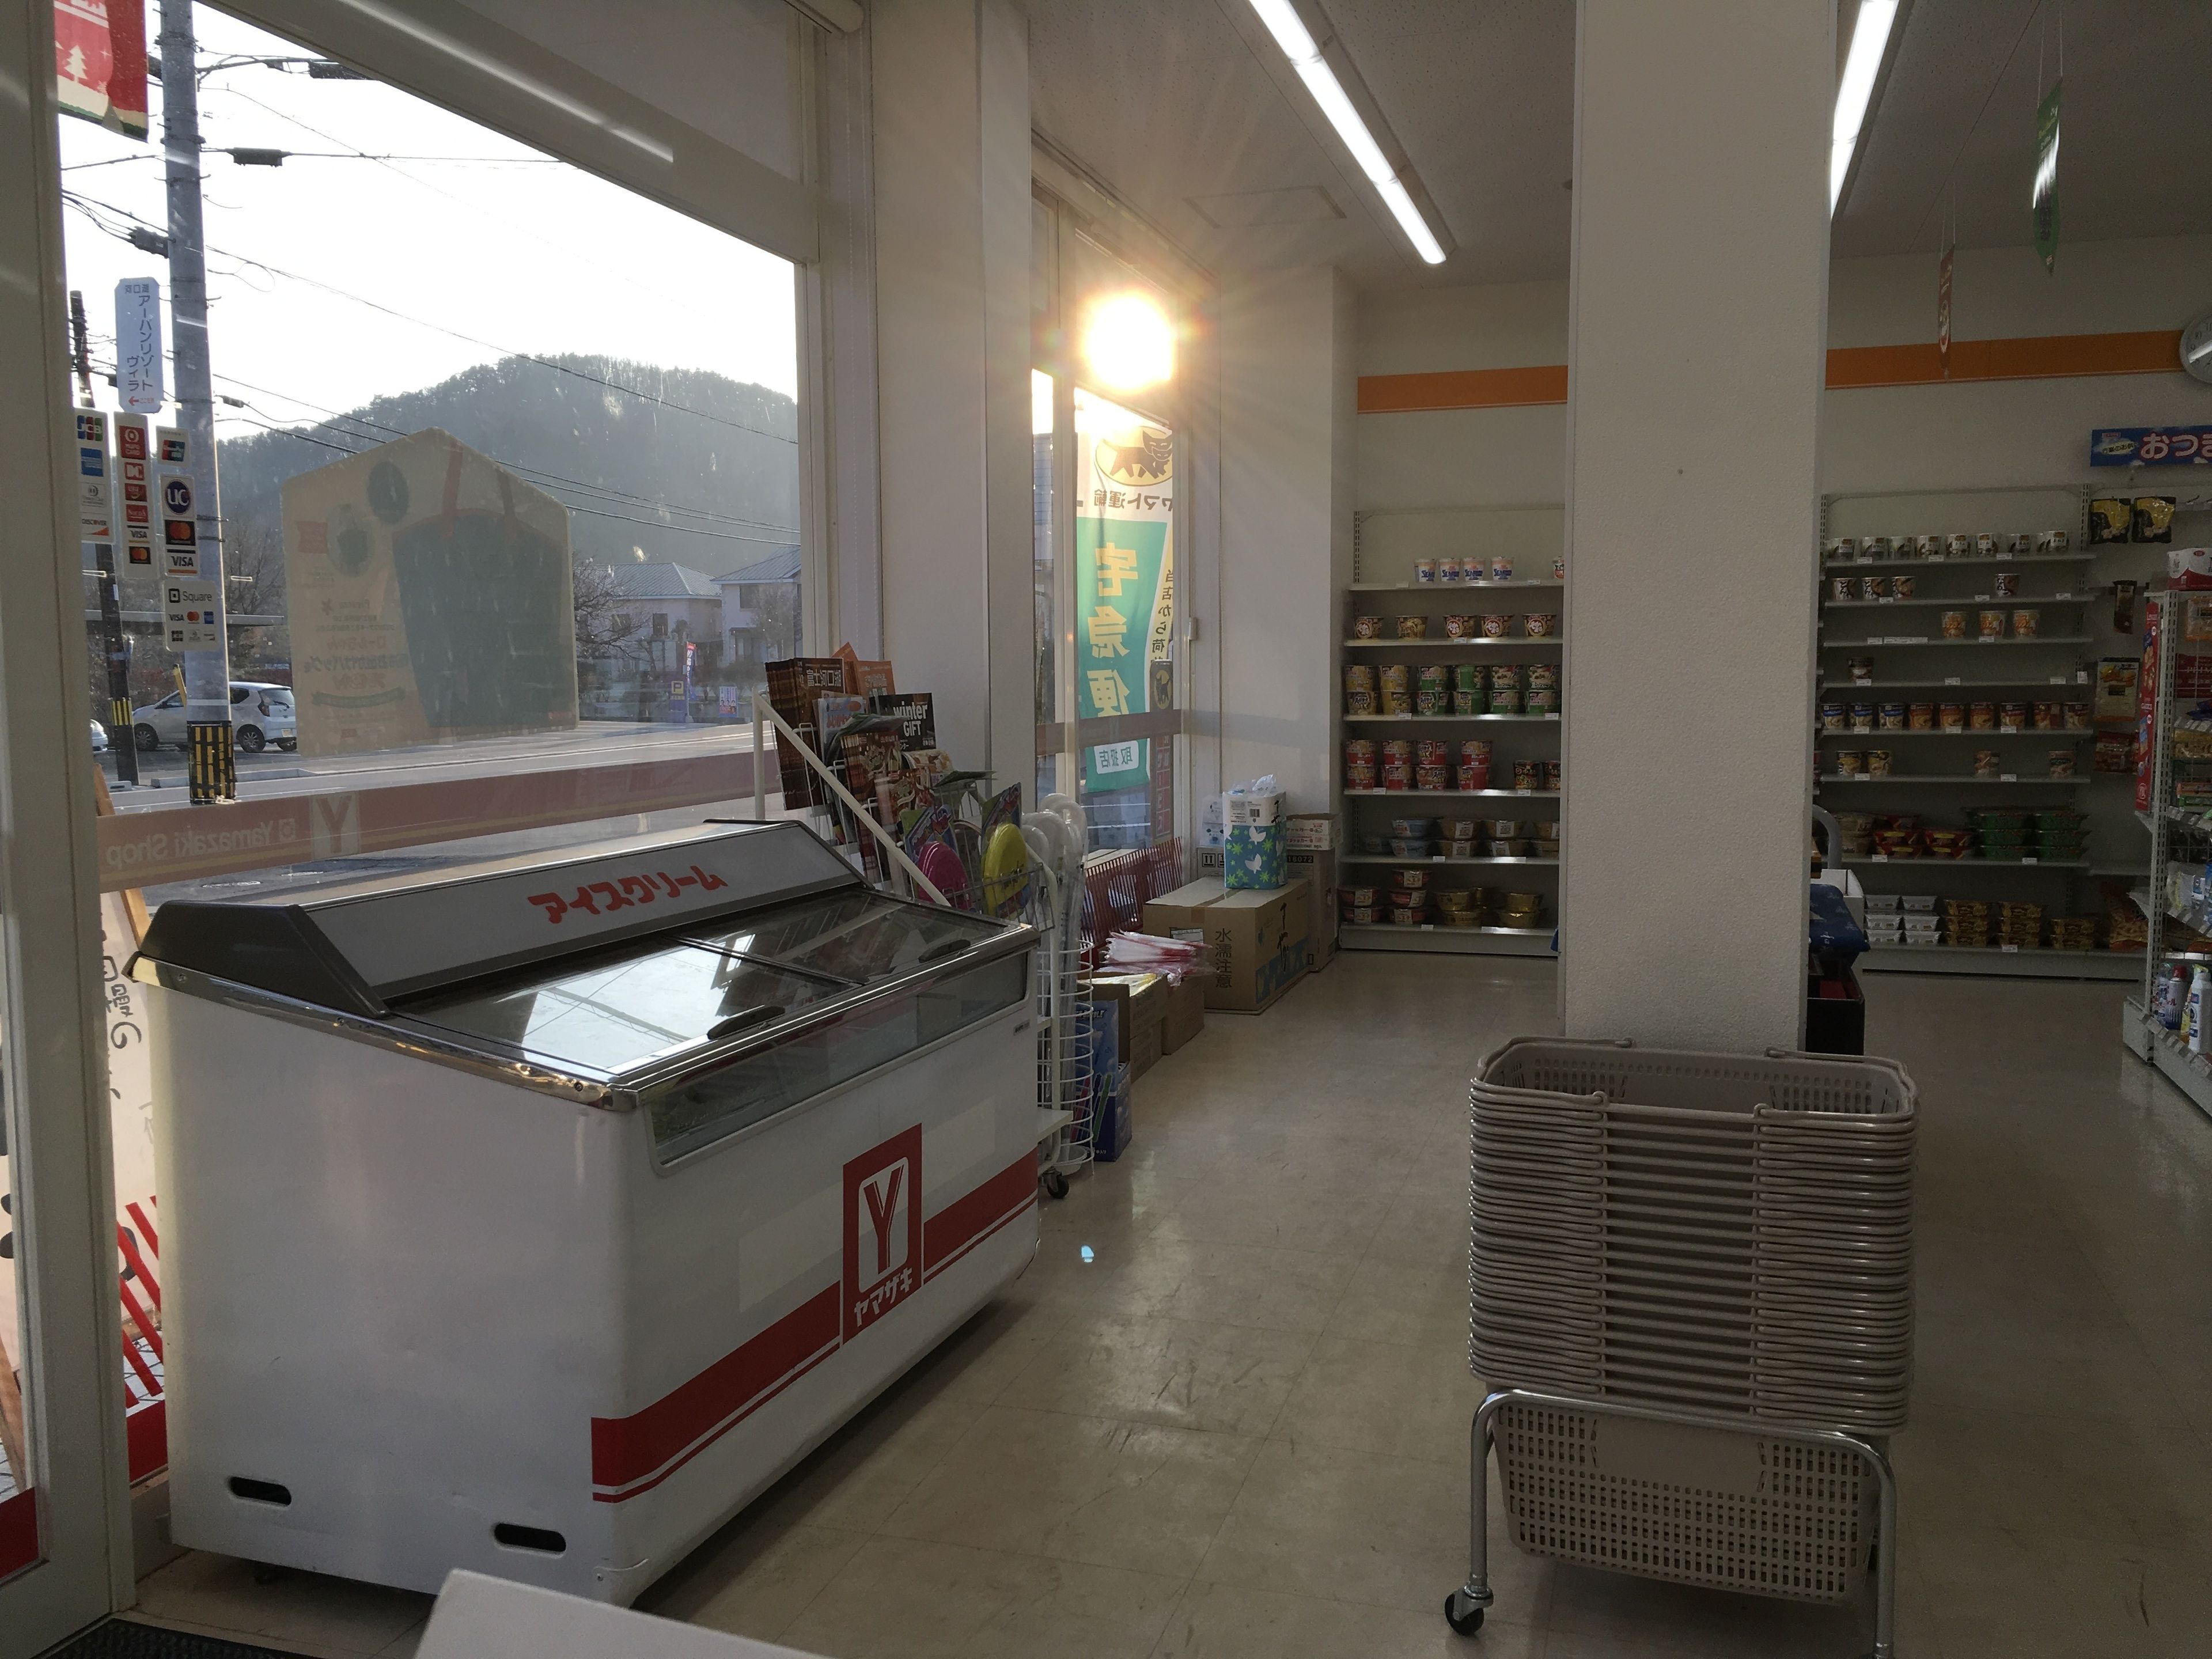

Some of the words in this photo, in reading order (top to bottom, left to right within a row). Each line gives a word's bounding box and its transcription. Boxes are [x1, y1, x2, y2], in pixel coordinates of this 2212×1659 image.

[126, 355, 140, 392] ヴィラ
[77, 423, 103, 434] JCB
[167, 488, 190, 506] UC
[130, 530, 147, 539] VISA
[171, 556, 194, 567] VISA
[183, 591, 213, 603] Square
[673, 682, 682, 692] P
[806, 669, 842, 687] 富士河口湖
[893, 700, 928, 719] winter
[903, 720, 922, 737] GIFT
[527, 865, 729, 924] アイスクリーム
[1214, 927, 1232, 988] 水濡注意
[854, 1267, 913, 1327] ヤマザキ
